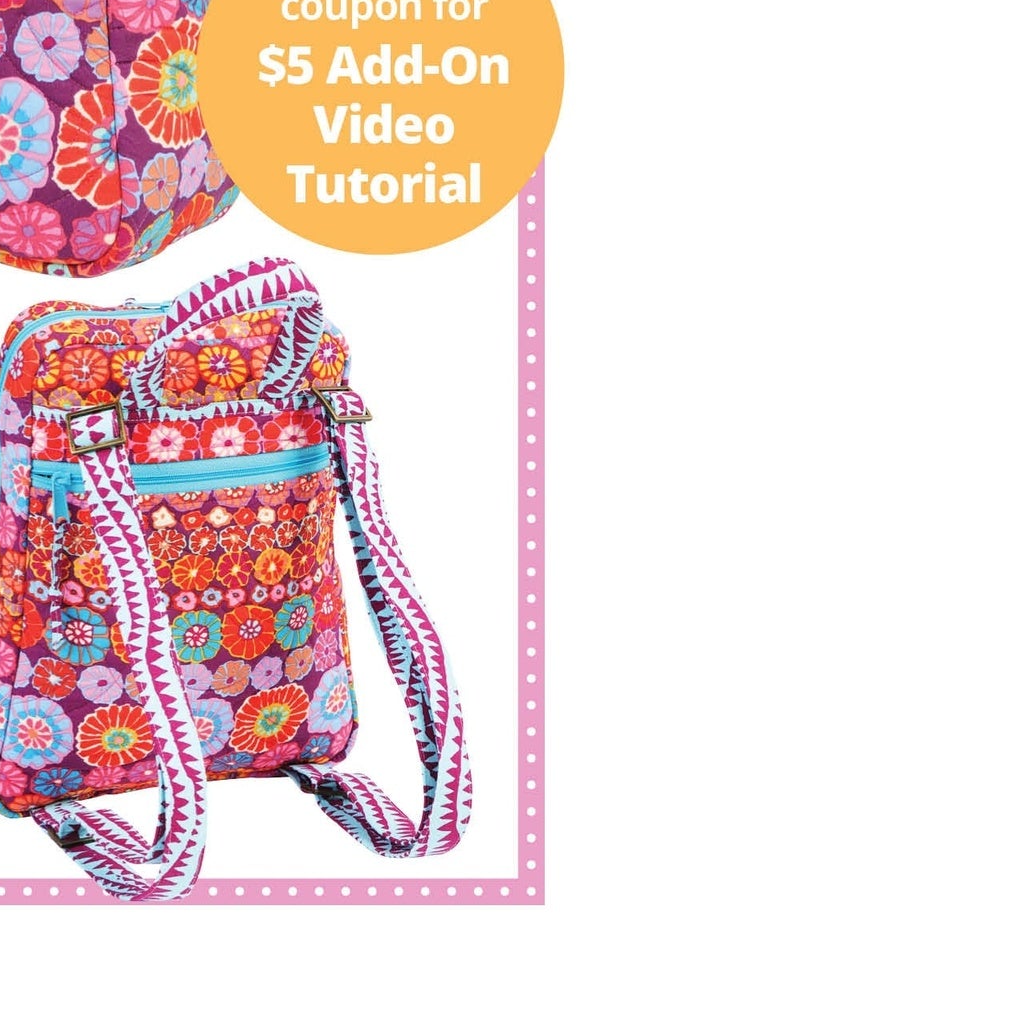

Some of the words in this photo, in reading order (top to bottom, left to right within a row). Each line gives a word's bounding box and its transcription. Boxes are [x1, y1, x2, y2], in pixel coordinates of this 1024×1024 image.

[258, 43, 314, 88] $5
[326, 43, 509, 85] Add-On
[313, 102, 455, 145] Video
[286, 161, 481, 204] Tutorial
